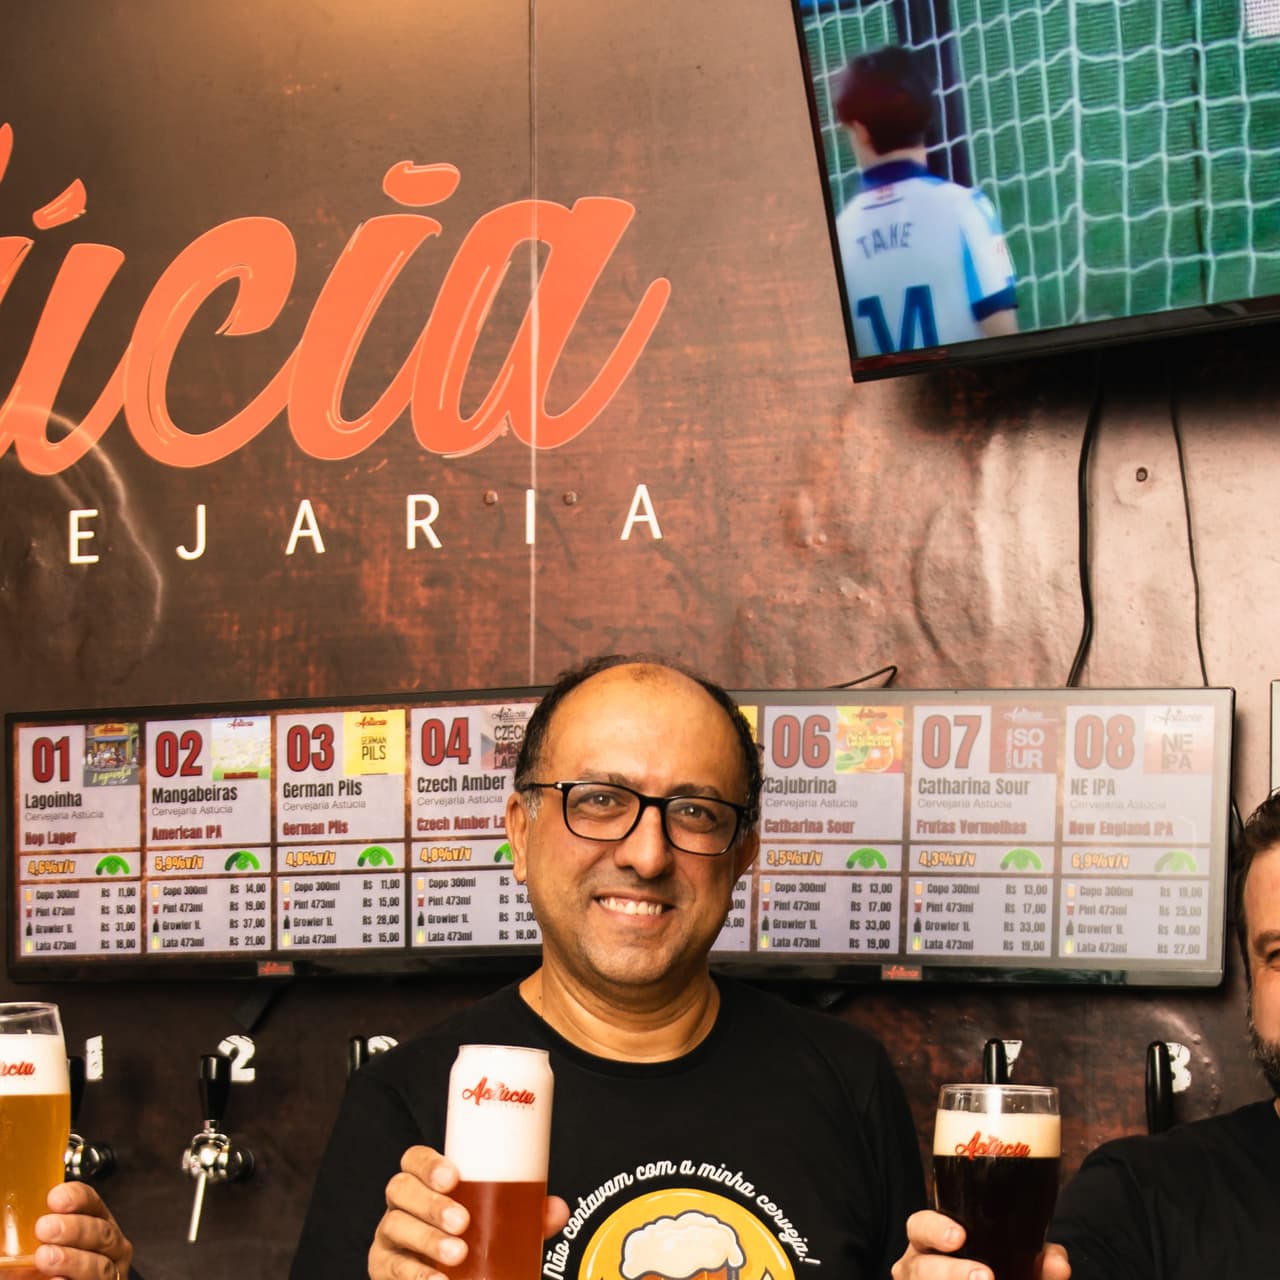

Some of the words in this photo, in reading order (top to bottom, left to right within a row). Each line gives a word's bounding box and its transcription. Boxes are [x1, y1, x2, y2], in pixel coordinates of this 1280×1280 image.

[287, 723, 335, 773] 03
[421, 717, 471, 766] 04
[494, 742, 522, 755] AMBE
[772, 714, 831, 769] 06
[922, 714, 982, 769] 07
[1074, 714, 1135, 770] 08
[32, 736, 70, 783] 01
[155, 730, 203, 778] 02
[361, 745, 386, 761] PILS
[283, 782, 334, 799] German
[338, 778, 362, 797] Pils
[417, 775, 457, 792] Czech
[462, 774, 506, 791] Amber
[765, 776, 836, 795] Cajubrina
[918, 777, 991, 795] Catharina
[995, 778, 1030, 795] Sour
[1070, 778, 1088, 796] NE
[1093, 778, 1116, 796] IPA
[25, 791, 82, 810] Lagoinha
[152, 784, 238, 805] Mangabeiras
[152, 825, 202, 840] American
[206, 824, 222, 839] IPA
[282, 822, 325, 836] German
[328, 820, 348, 834] Pils
[417, 817, 450, 831] Czech
[454, 816, 490, 830] Amber
[764, 818, 823, 834] Catharina
[827, 819, 855, 834] Sour
[916, 819, 956, 834] Frutas
[960, 819, 1027, 834] Vermelhas
[25, 832, 45, 846] Hop
[47, 831, 77, 845] Lager
[217, 1034, 255, 1083] 2
[543, 1239, 570, 1280] Não
[563, 1171, 634, 1239] contavam
[636, 1160, 676, 1181] com
[679, 1159, 695, 1175] a
[698, 1162, 756, 1198] minha
[756, 1194, 822, 1266] cerveja!
